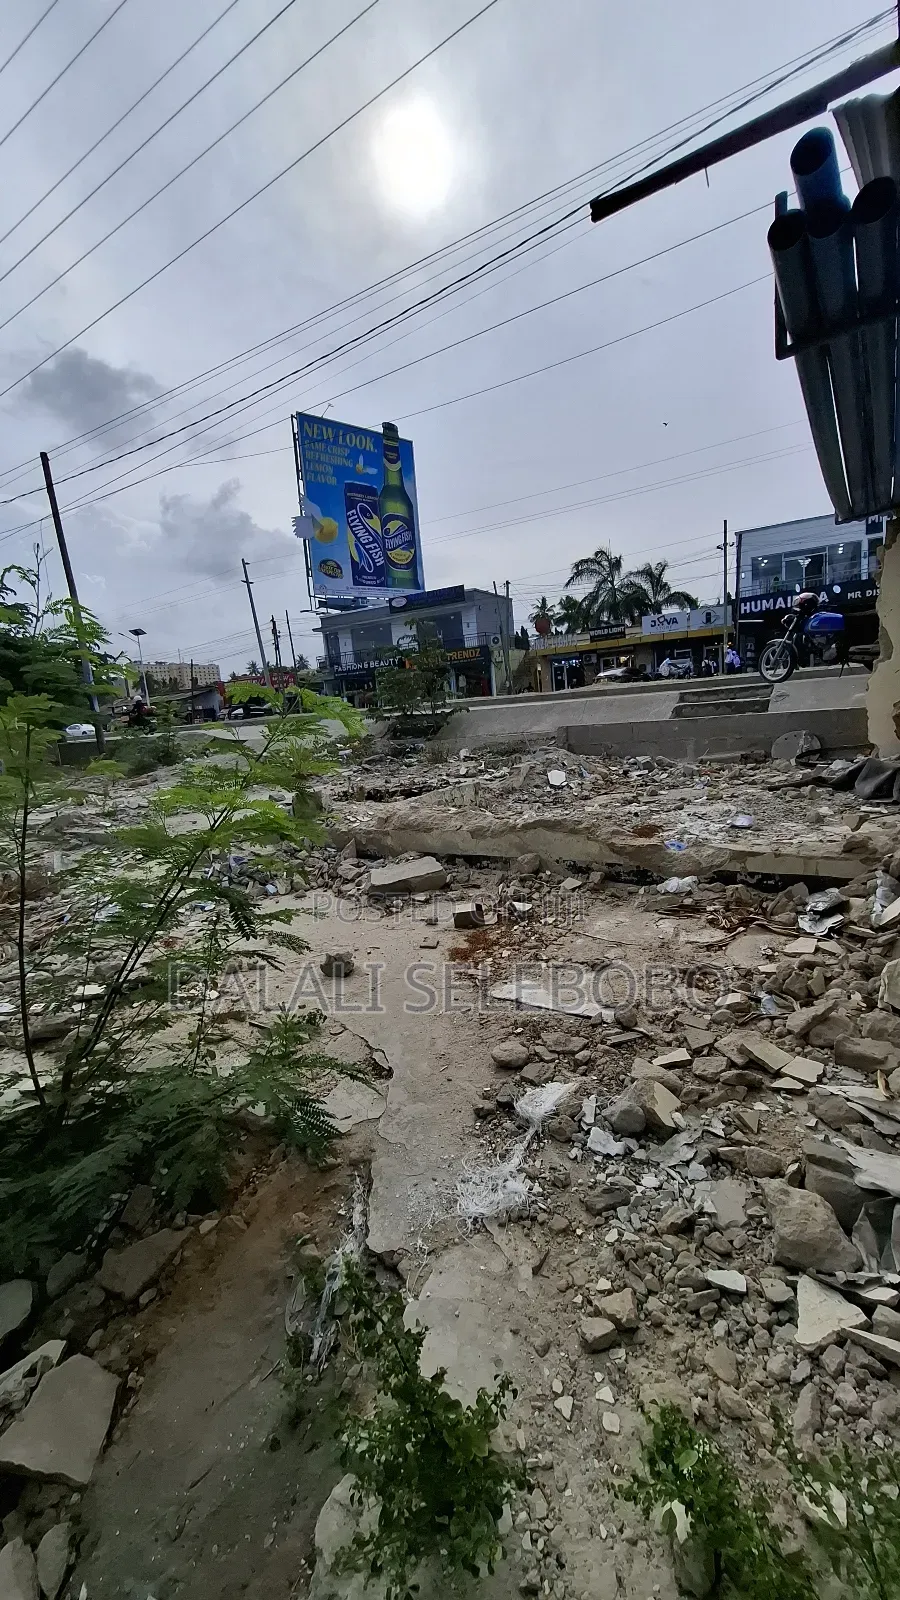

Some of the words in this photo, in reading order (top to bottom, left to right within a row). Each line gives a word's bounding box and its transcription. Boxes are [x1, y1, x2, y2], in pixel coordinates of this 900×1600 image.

[303, 421, 336, 442] NEW
[338, 429, 377, 453] LOOK.
[304, 440, 327, 452] SAME
[327, 444, 350, 457] CRISP
[305, 450, 353, 467] REFRESHING
[306, 460, 334, 474] LEMON
[307, 472, 337, 485] FLAVOR
[347, 509, 373, 544] FLYING
[365, 542, 385, 567] FISH
[385, 536, 403, 549] FLYING
[401, 530, 413, 543] FISH
[590, 627, 608, 637] WORLD
[608, 625, 625, 634] LIGHT
[447, 648, 482, 661] TRENDZ
[334, 661, 363, 673] FASHION
[363, 660, 369, 669] &
[369, 657, 399, 668] BEAUTY
